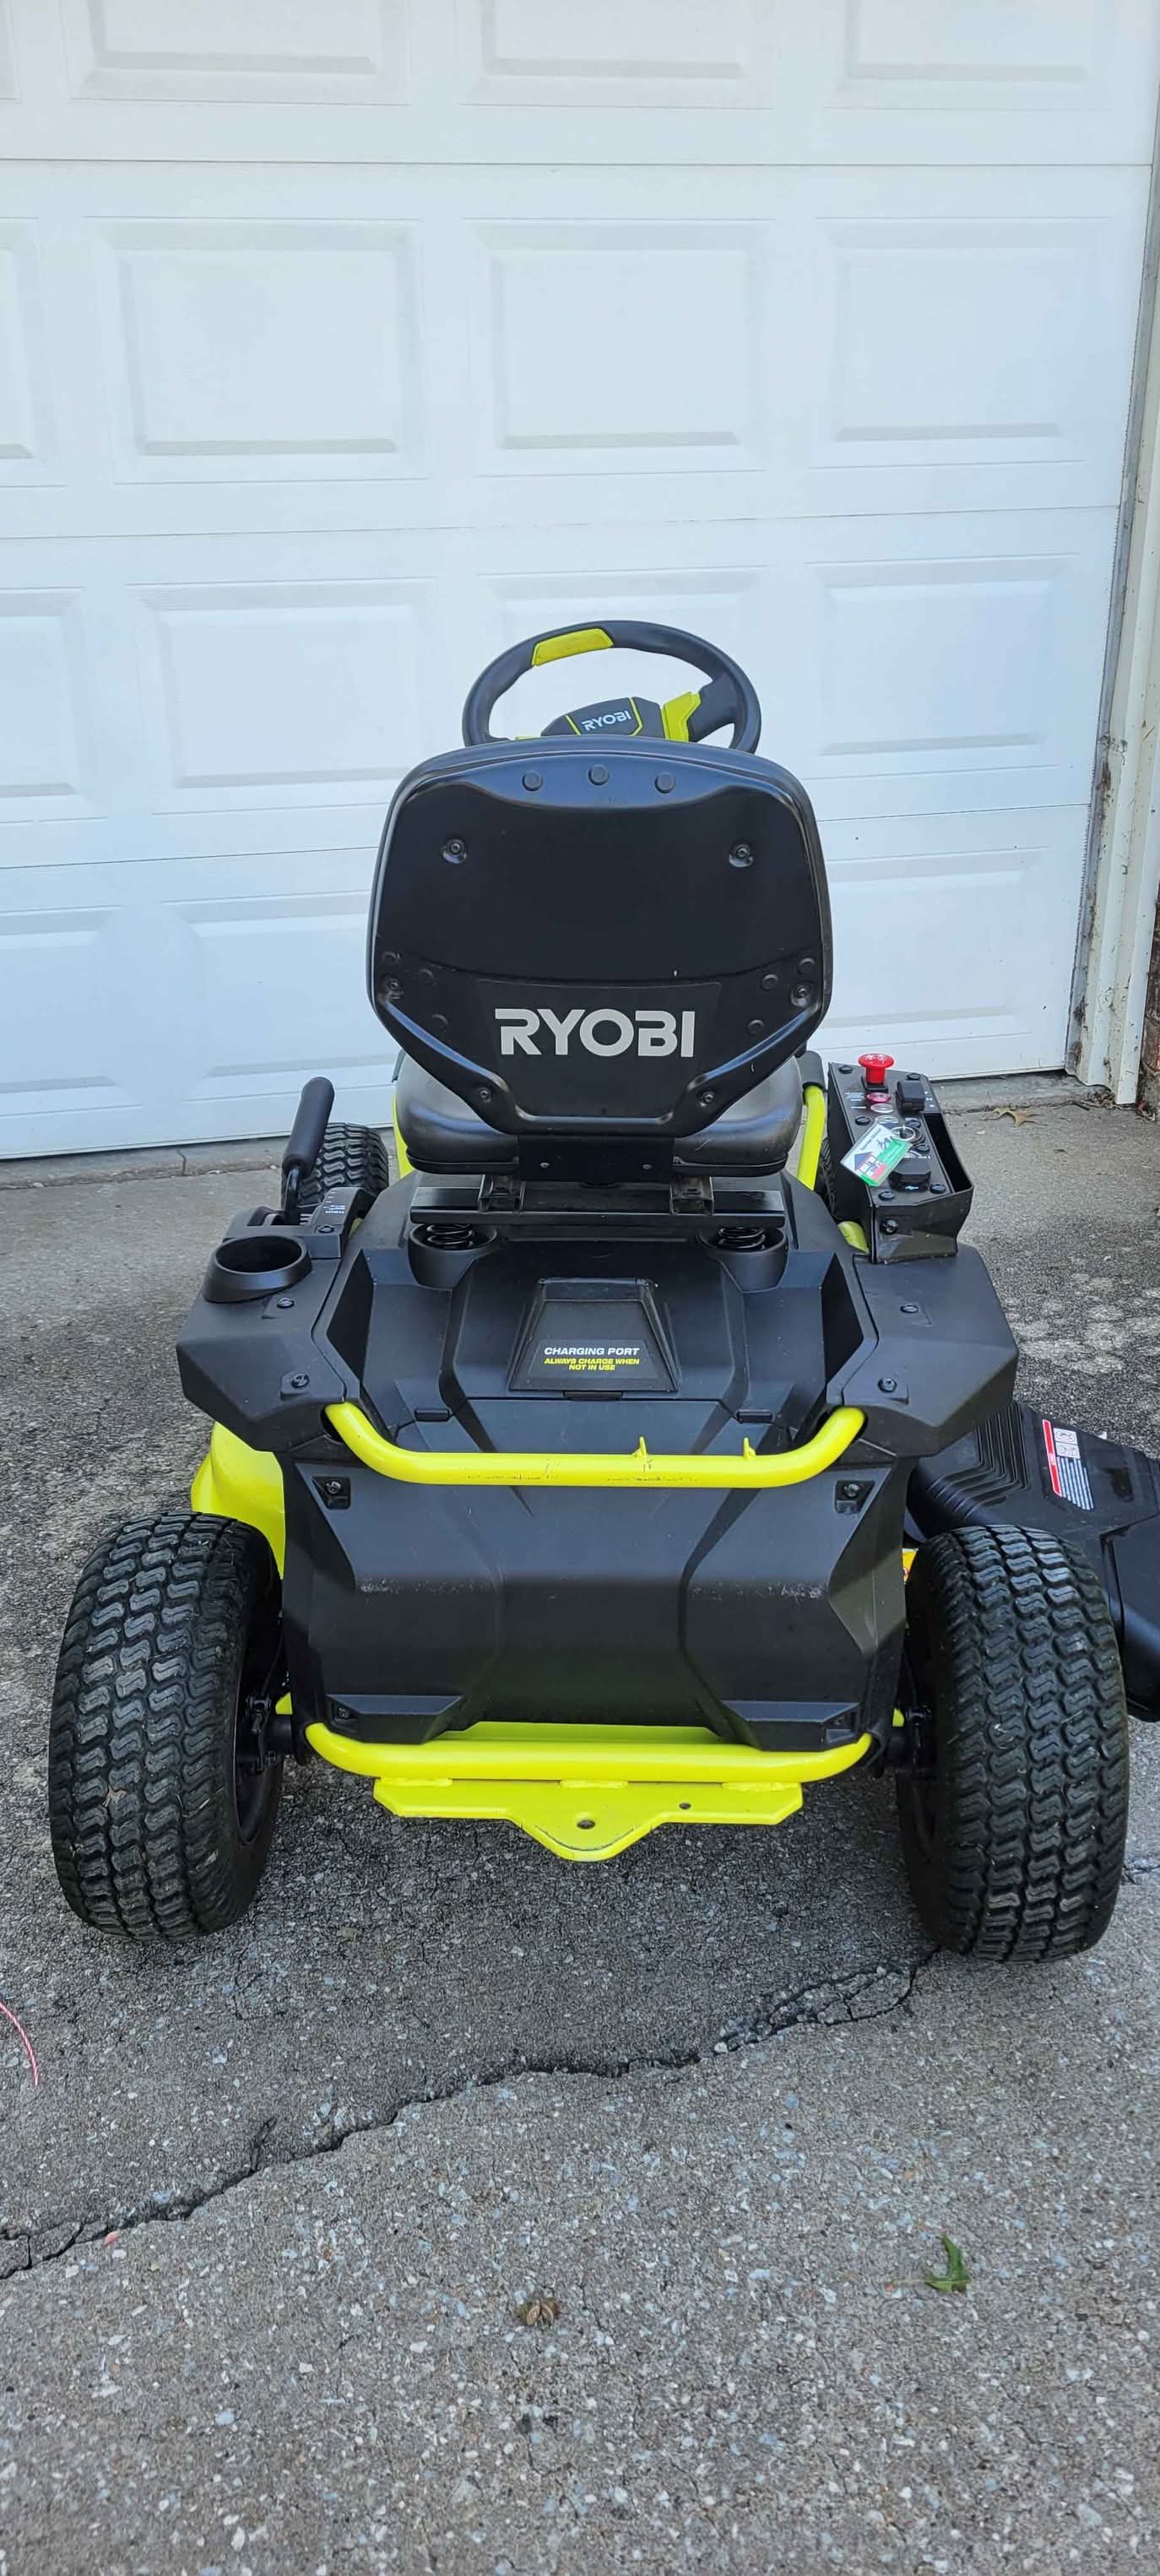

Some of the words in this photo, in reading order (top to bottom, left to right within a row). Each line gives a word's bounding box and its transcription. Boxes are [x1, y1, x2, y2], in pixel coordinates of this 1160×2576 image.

[581, 710, 632, 731] RYOBI
[495, 1008, 696, 1058] RYOBI
[544, 1347, 605, 1356] CHARGING
[607, 1348, 640, 1356] PORT
